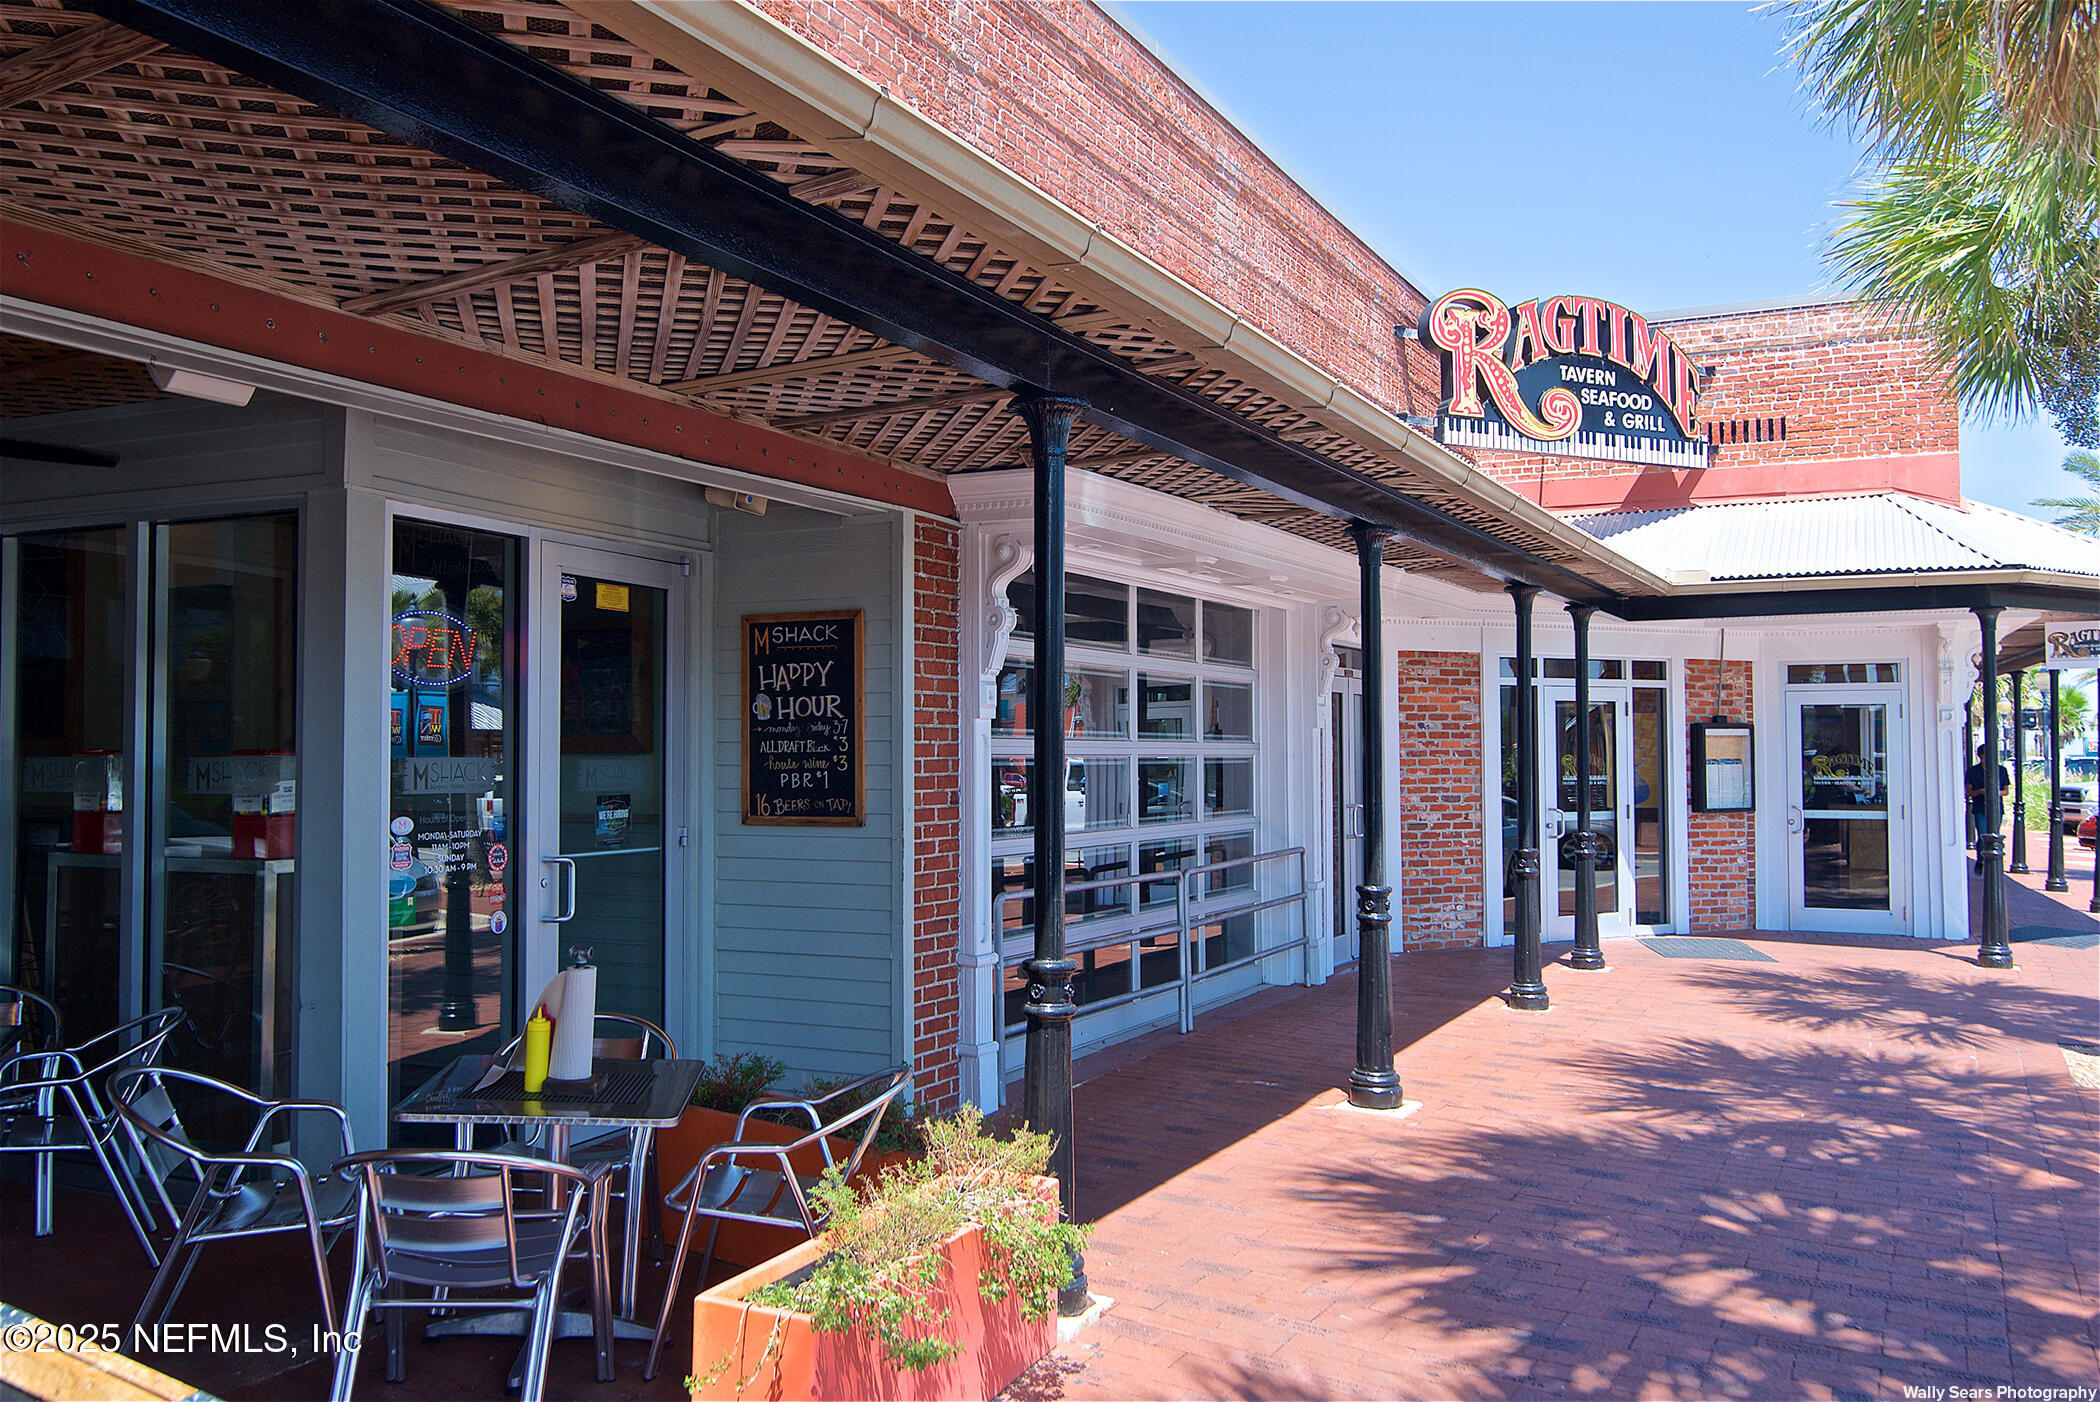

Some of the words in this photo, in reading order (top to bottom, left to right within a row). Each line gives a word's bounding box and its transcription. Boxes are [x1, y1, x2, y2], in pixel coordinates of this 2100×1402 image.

[1427, 288, 1701, 441] RAGTIME
[1560, 364, 1617, 388] TAVERN
[1580, 387, 1654, 411] SEAFOOD
[1604, 412, 1617, 427] &
[1622, 414, 1667, 433] GRILL
[391, 624, 478, 671] OPEN
[758, 660, 834, 692] HAPPY
[777, 695, 844, 720] HOUR
[764, 754, 800, 770] house
[802, 757, 830, 770] wine
[780, 772, 814, 789] PBR
[756, 793, 771, 817] 16
[773, 797, 811, 815] BEERS
[436, 853, 465, 862] SUNDAY
[444, 864, 457, 873] AM
[461, 863, 466, 871] 9
[467, 863, 477, 871] PM
